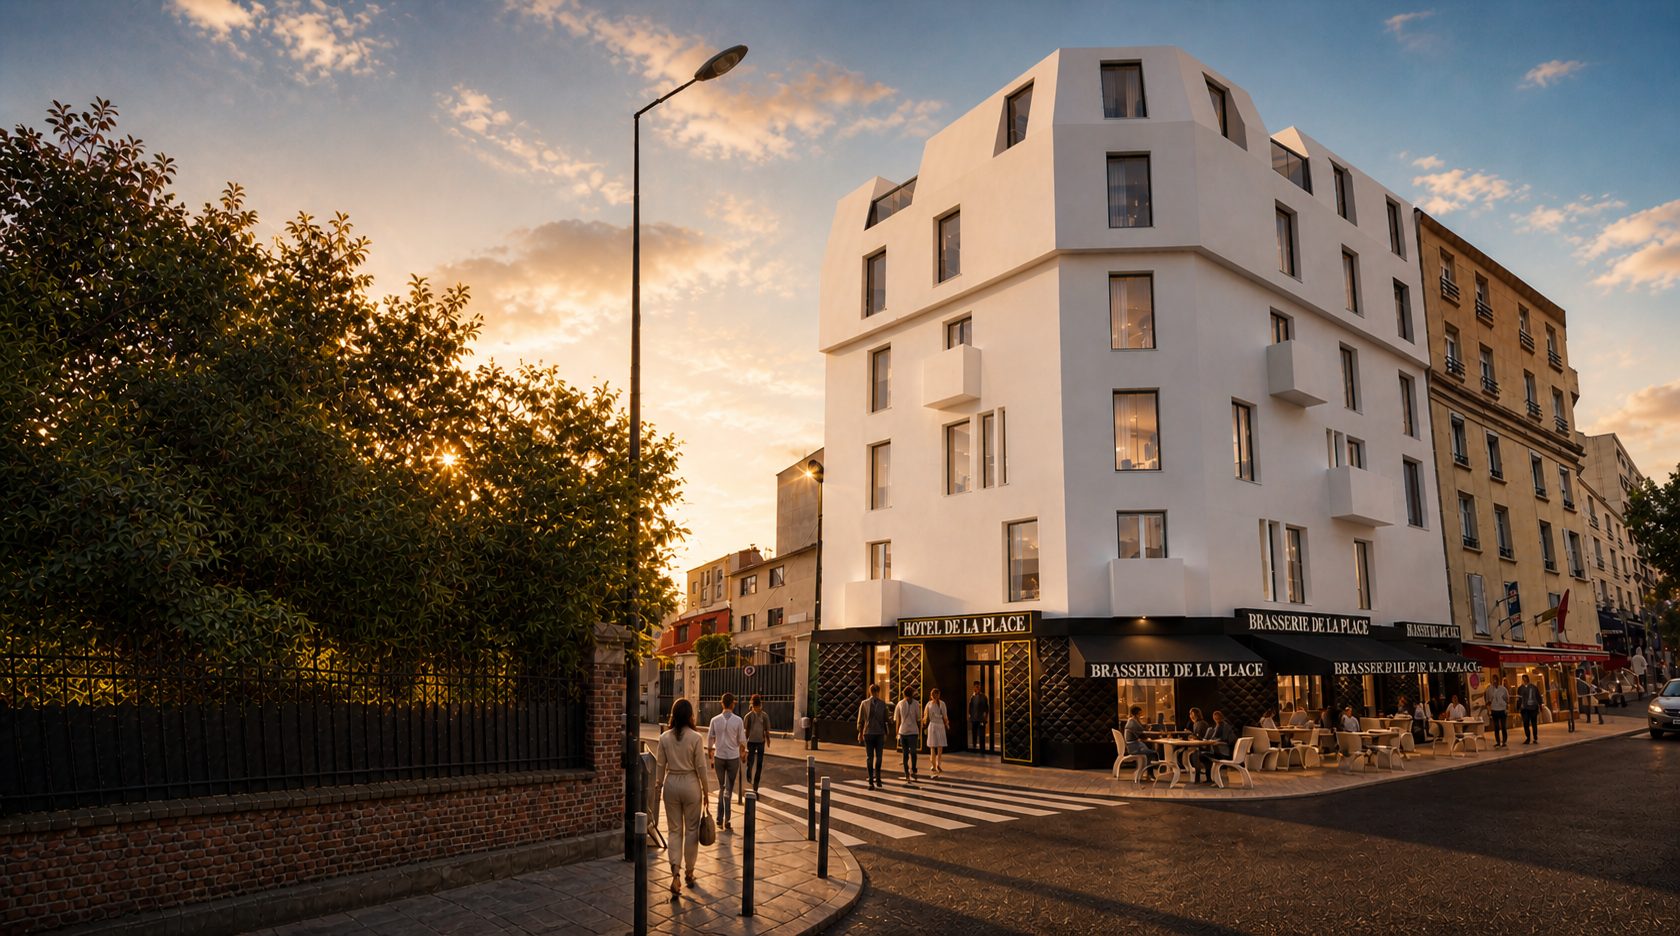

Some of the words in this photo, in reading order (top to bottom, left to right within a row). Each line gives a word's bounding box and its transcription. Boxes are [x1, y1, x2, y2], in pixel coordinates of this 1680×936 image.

[903, 620, 942, 636] HOTEL
[944, 619, 960, 634] DE
[963, 618, 979, 634] LA
[982, 615, 1025, 633] PLACE
[1248, 613, 1309, 631] BRASSERIE
[1311, 617, 1325, 632] DE
[1326, 617, 1338, 633] LA
[1340, 619, 1369, 635] PLACE
[1090, 663, 1170, 678] BRASSERIE
[1174, 663, 1193, 677] DE
[1196, 663, 1216, 677] LA
[1219, 662, 1263, 677] PLACE
